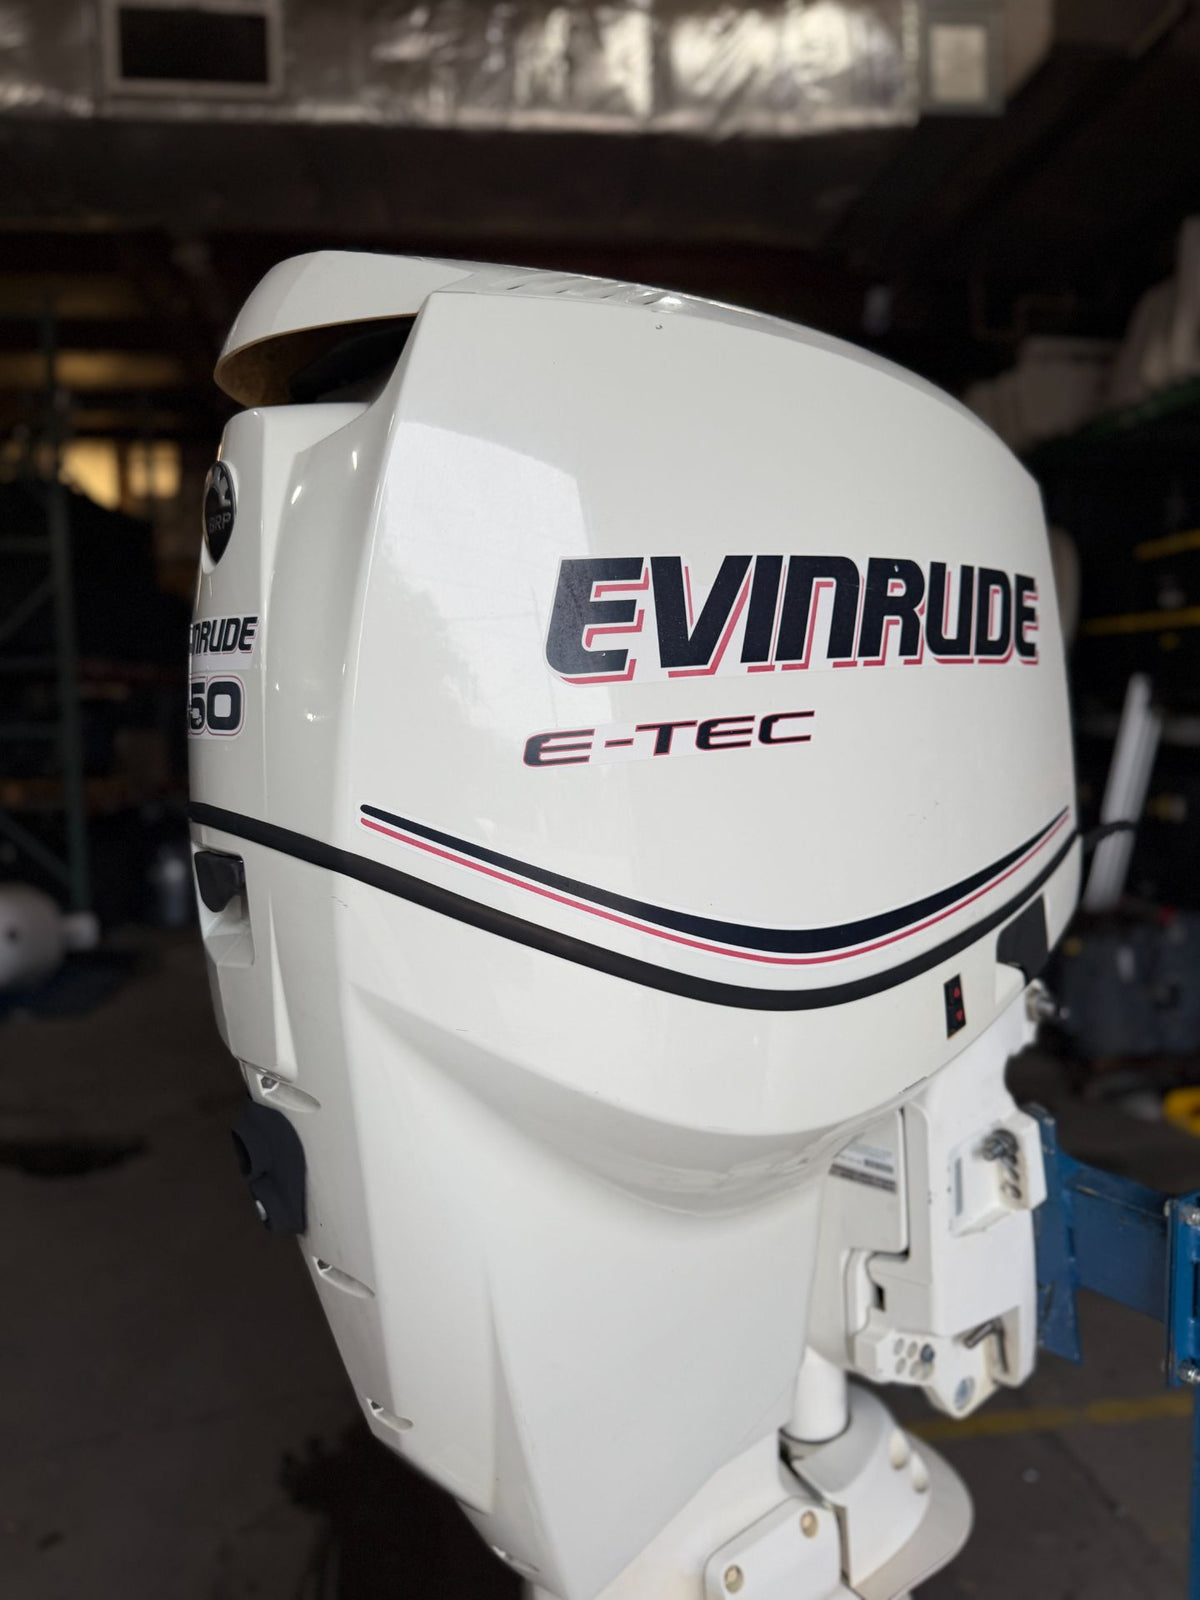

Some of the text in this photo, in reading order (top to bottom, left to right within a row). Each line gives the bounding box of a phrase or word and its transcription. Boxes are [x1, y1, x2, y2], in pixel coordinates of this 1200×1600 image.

[190, 616, 258, 655] NRUDE
[545, 554, 1039, 685] EVINRUDE
[523, 709, 815, 768] E-TEC
